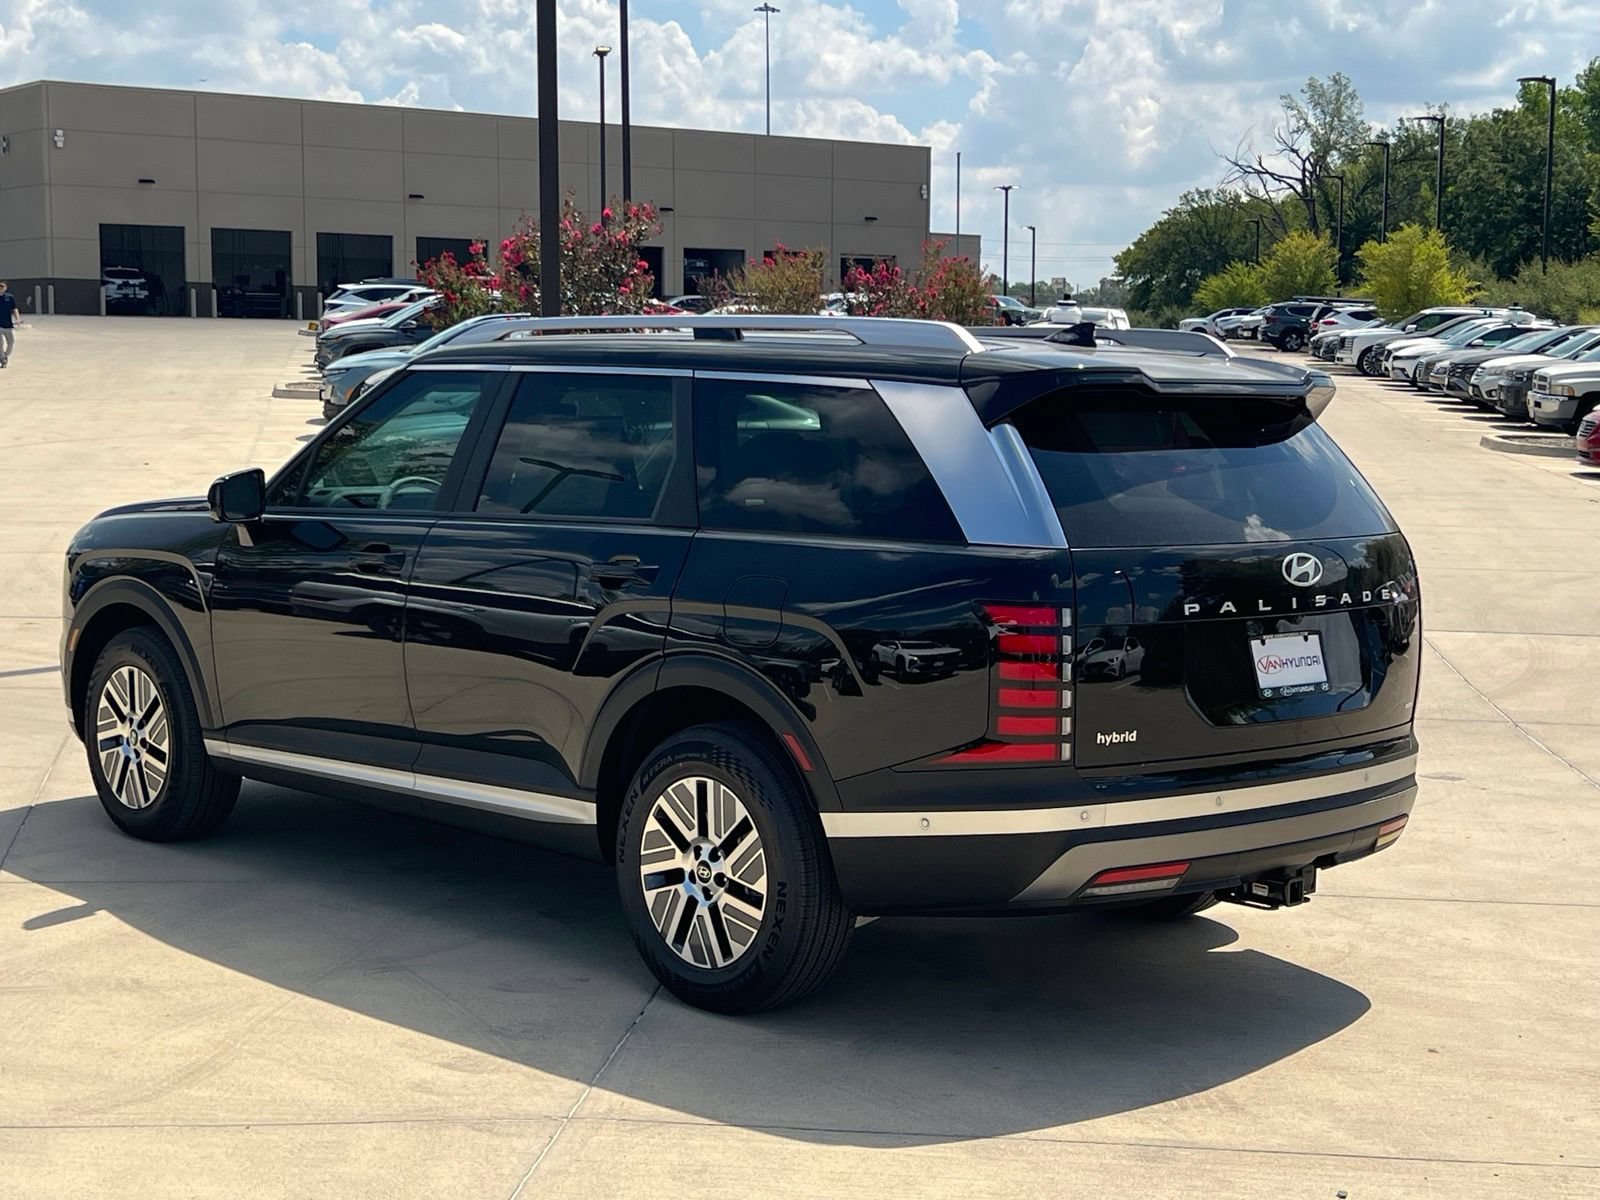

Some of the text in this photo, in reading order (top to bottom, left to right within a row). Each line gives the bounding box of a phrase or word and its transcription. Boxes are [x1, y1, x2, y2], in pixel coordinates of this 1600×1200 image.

[1184, 589, 1392, 616] PALISADE
[1096, 730, 1137, 746] hybrid
[619, 787, 639, 864] NEXEN
[761, 881, 788, 959] NEXEN
